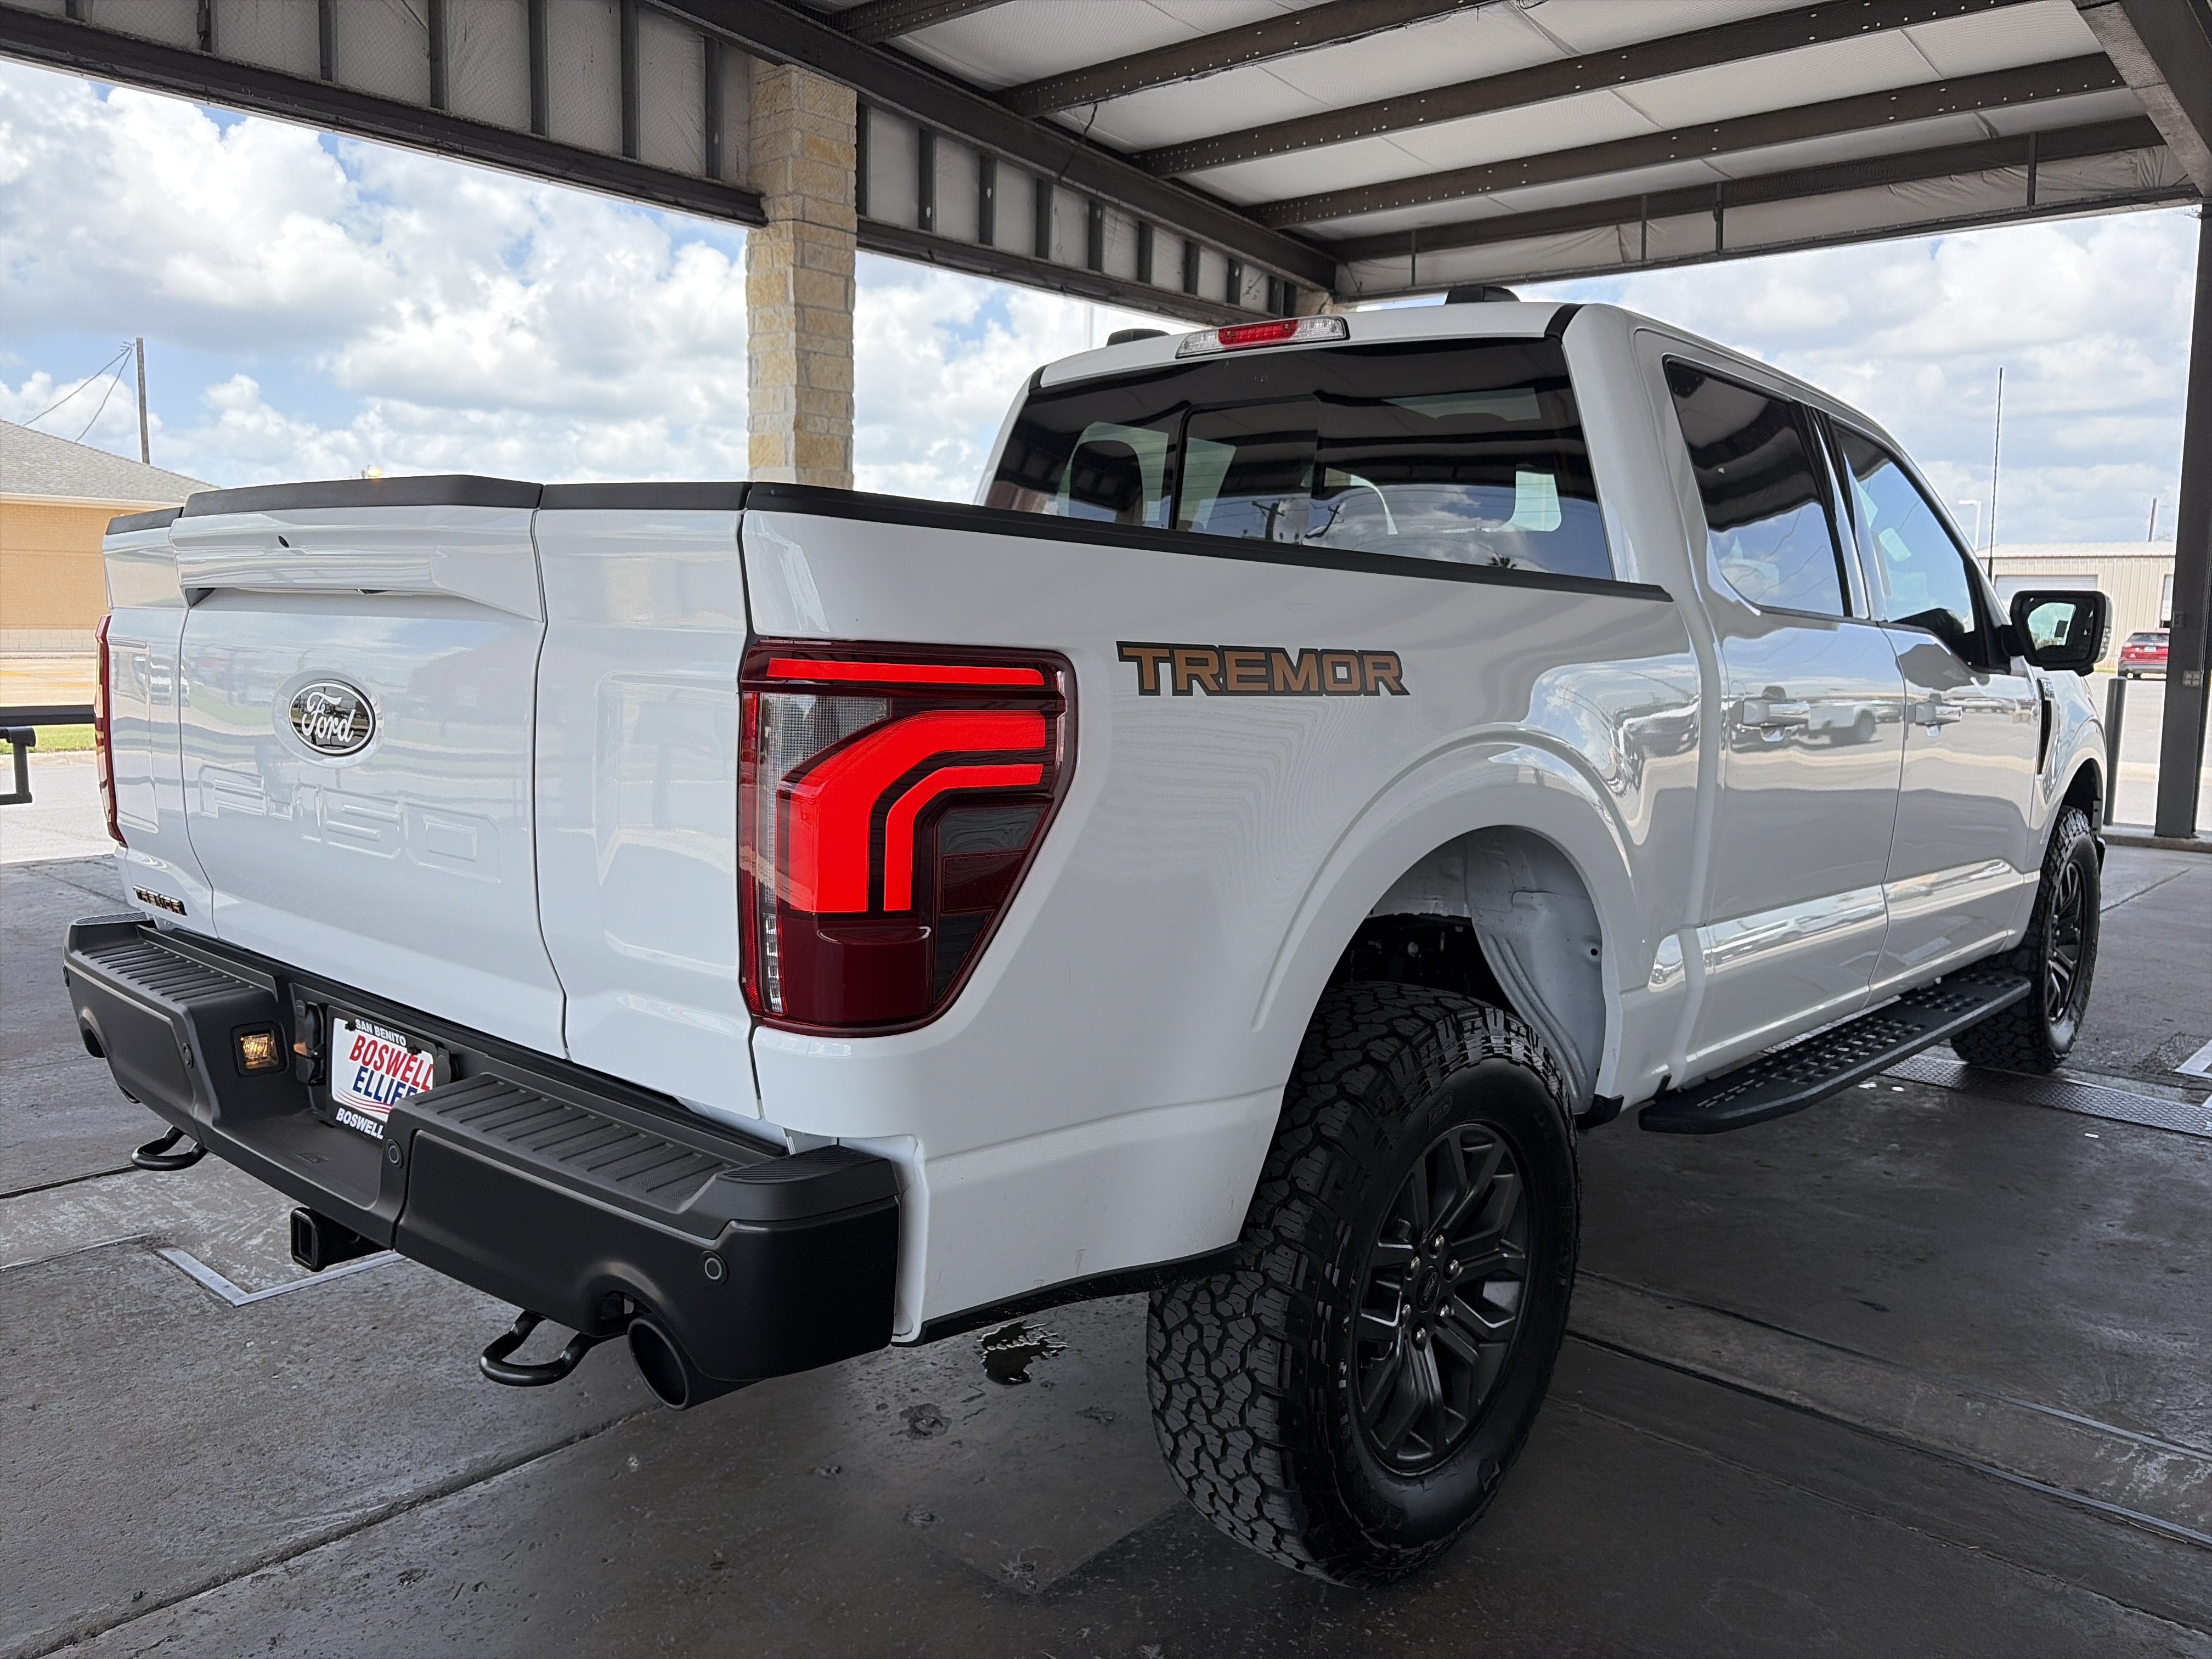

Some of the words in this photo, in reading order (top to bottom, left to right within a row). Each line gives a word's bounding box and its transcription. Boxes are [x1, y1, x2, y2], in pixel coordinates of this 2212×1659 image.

[1116, 641, 1410, 696] TREMOR
[301, 690, 357, 744] Ford
[199, 764, 501, 883] F-150
[355, 1018, 373, 1034] SAN
[373, 1025, 407, 1047] BENITO
[349, 1034, 433, 1091] BOSWELL
[336, 1107, 383, 1140] BOSWELL
